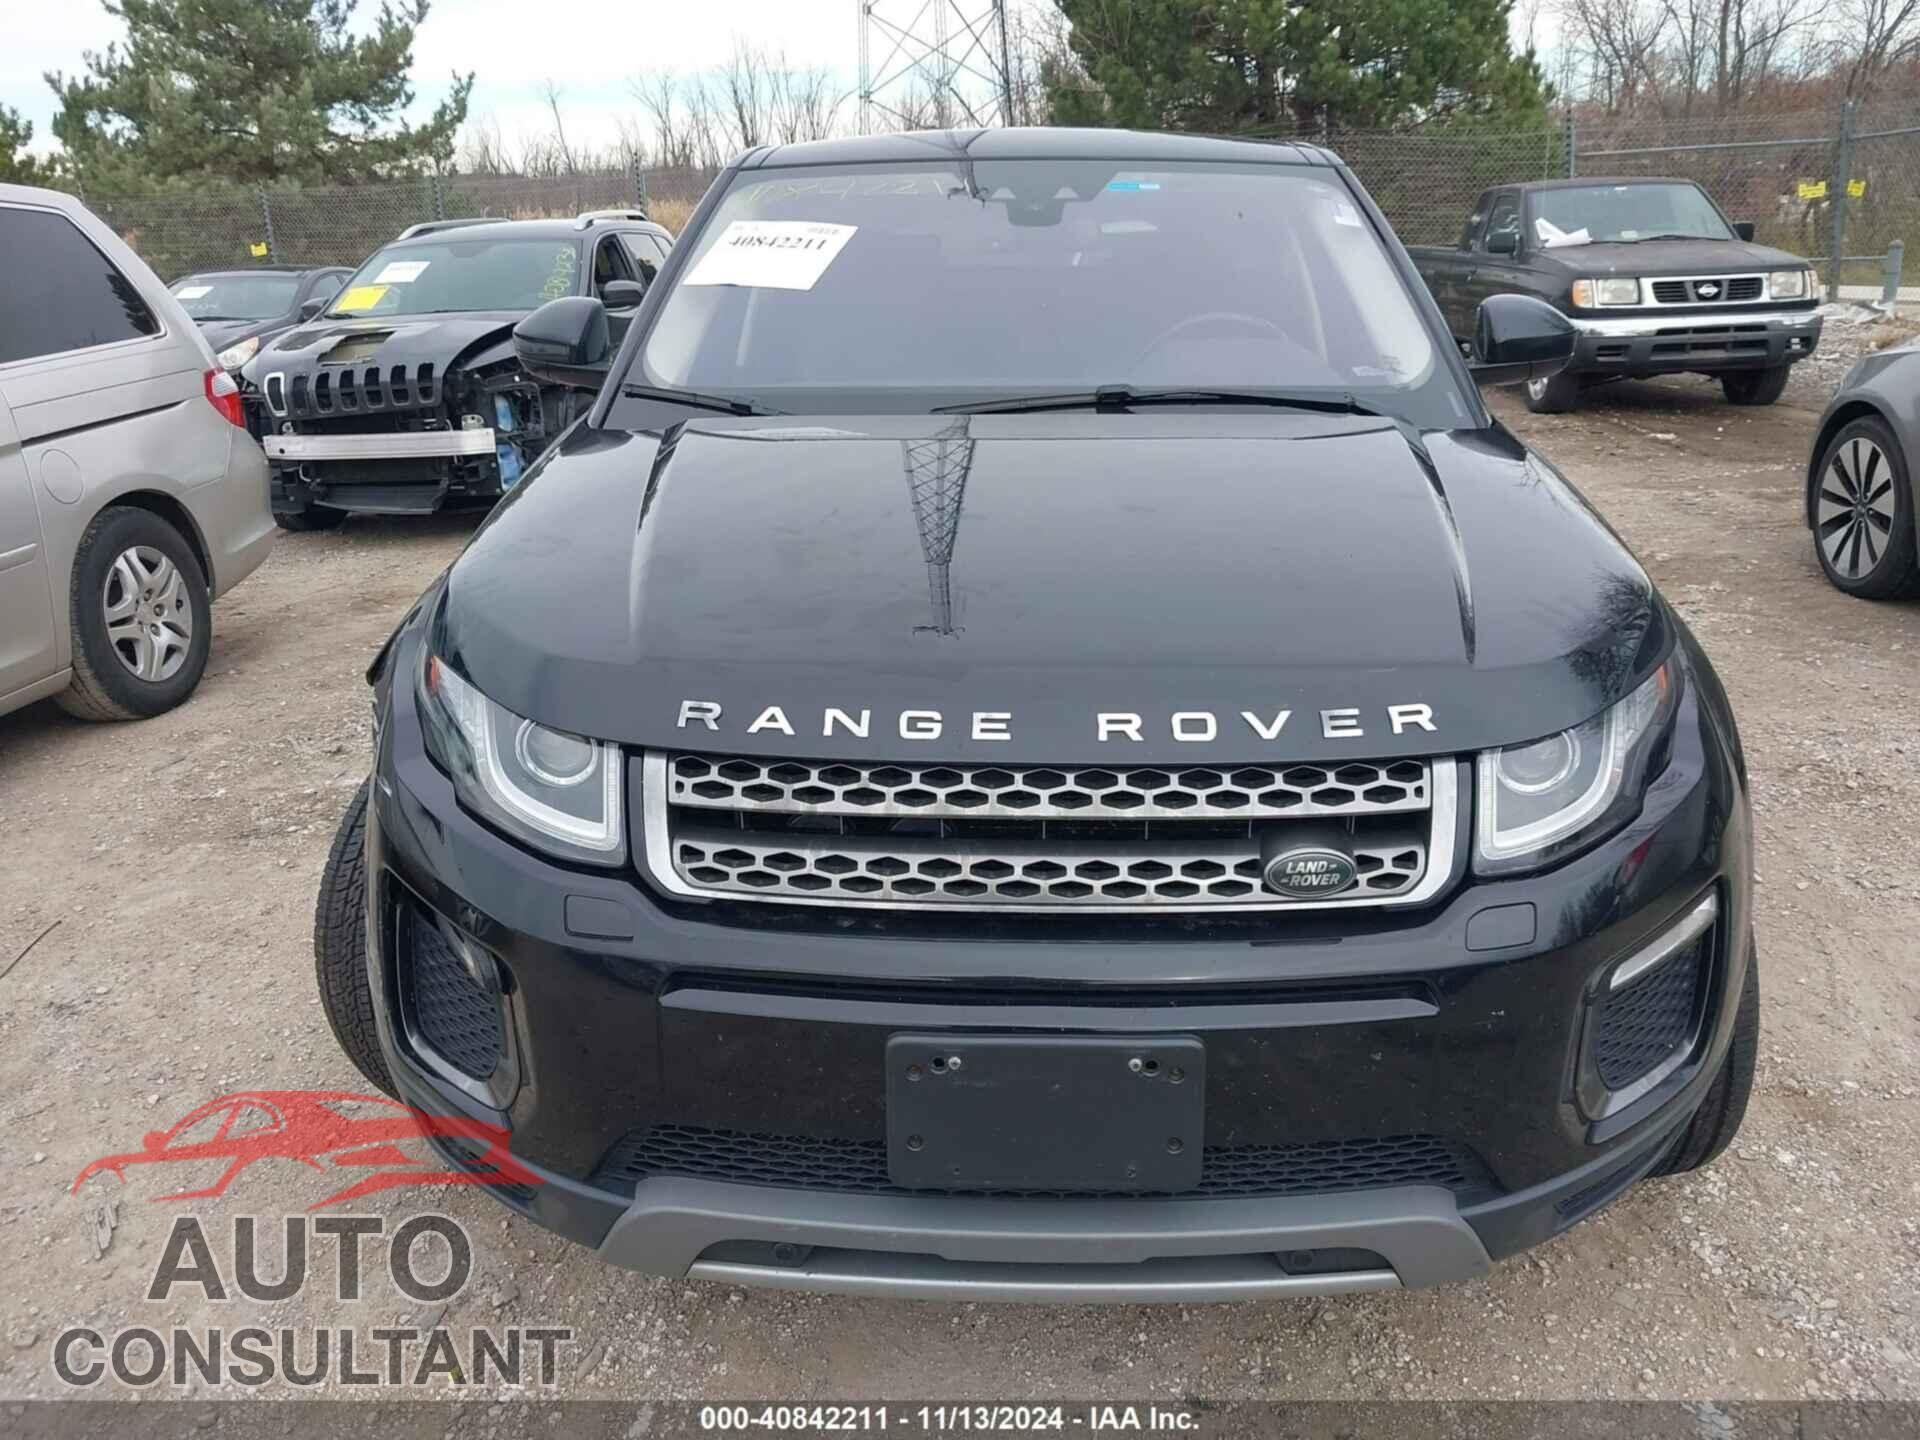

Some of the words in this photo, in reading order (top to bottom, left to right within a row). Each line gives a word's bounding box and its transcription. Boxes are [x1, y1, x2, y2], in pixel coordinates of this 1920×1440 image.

[728, 235, 828, 251] 40842211
[676, 699, 1012, 741] RANGE
[1096, 702, 1438, 742] ROVER
